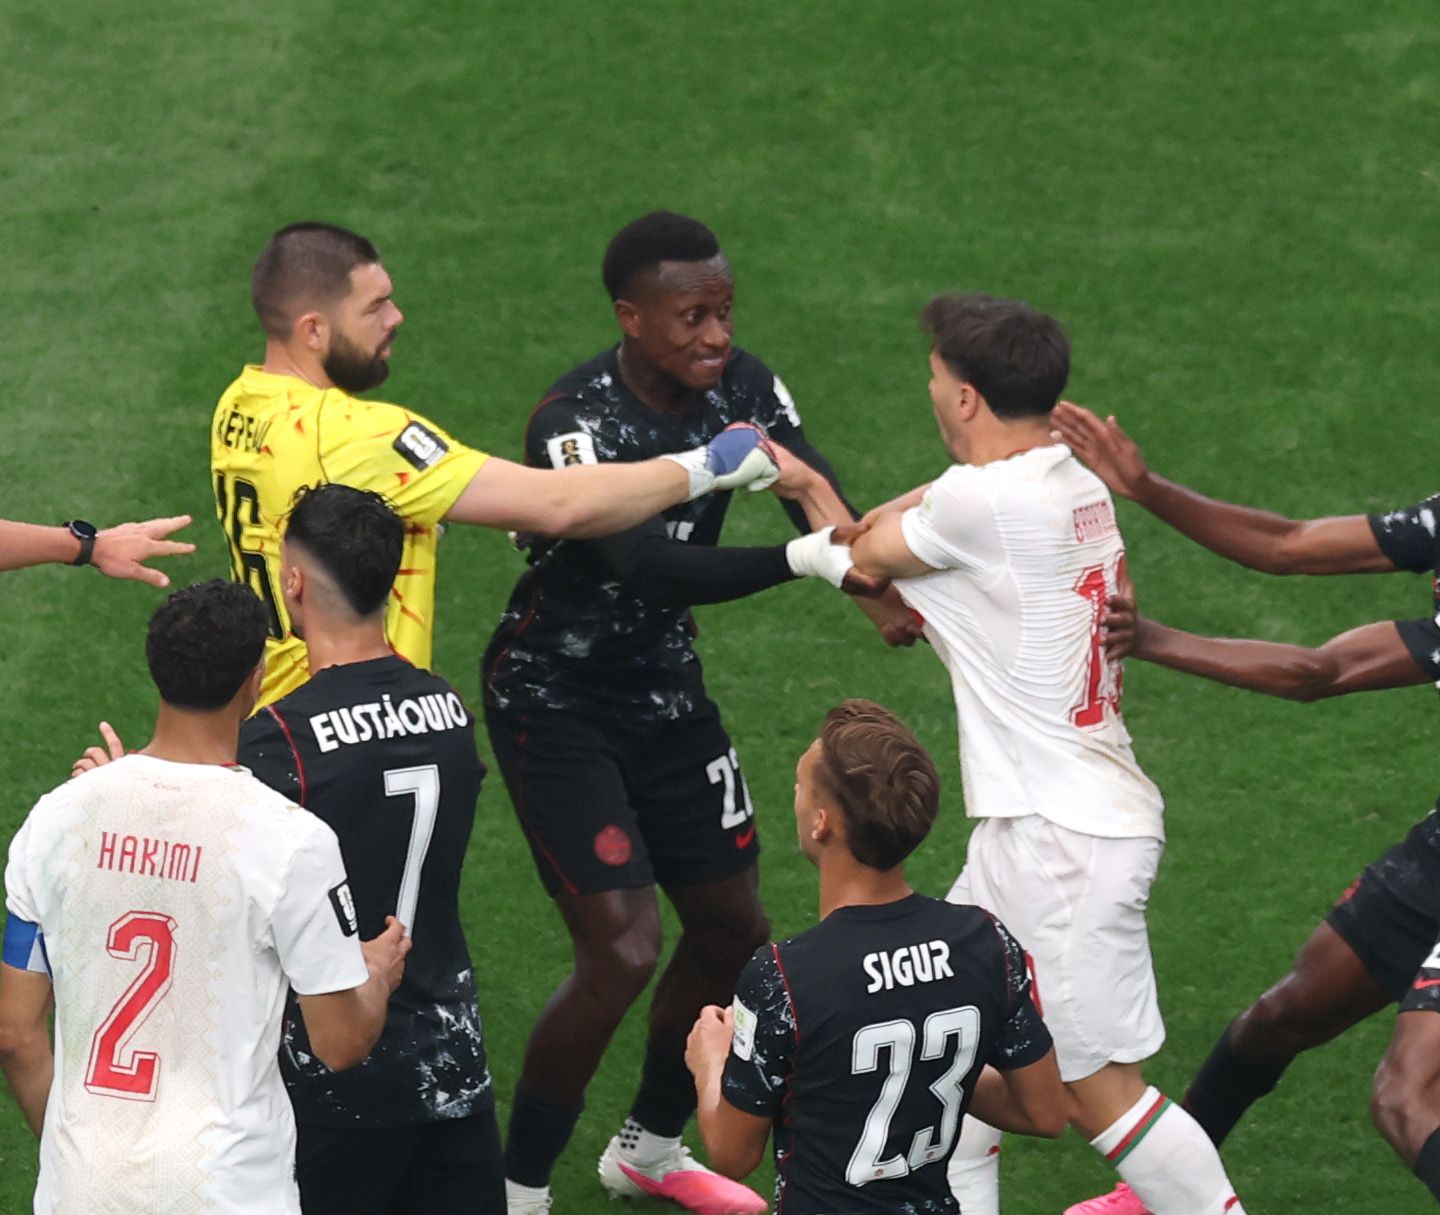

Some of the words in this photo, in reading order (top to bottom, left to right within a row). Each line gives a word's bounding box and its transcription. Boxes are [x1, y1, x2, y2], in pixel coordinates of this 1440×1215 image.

[310, 693, 469, 753] EUSTÁQUIO
[1069, 550, 1126, 733] 1
[97, 831, 203, 883] HAKIMI
[383, 763, 441, 938] 7
[84, 910, 178, 1101] 2
[863, 938, 955, 994] SIGUR
[845, 1004, 982, 1187] 23
